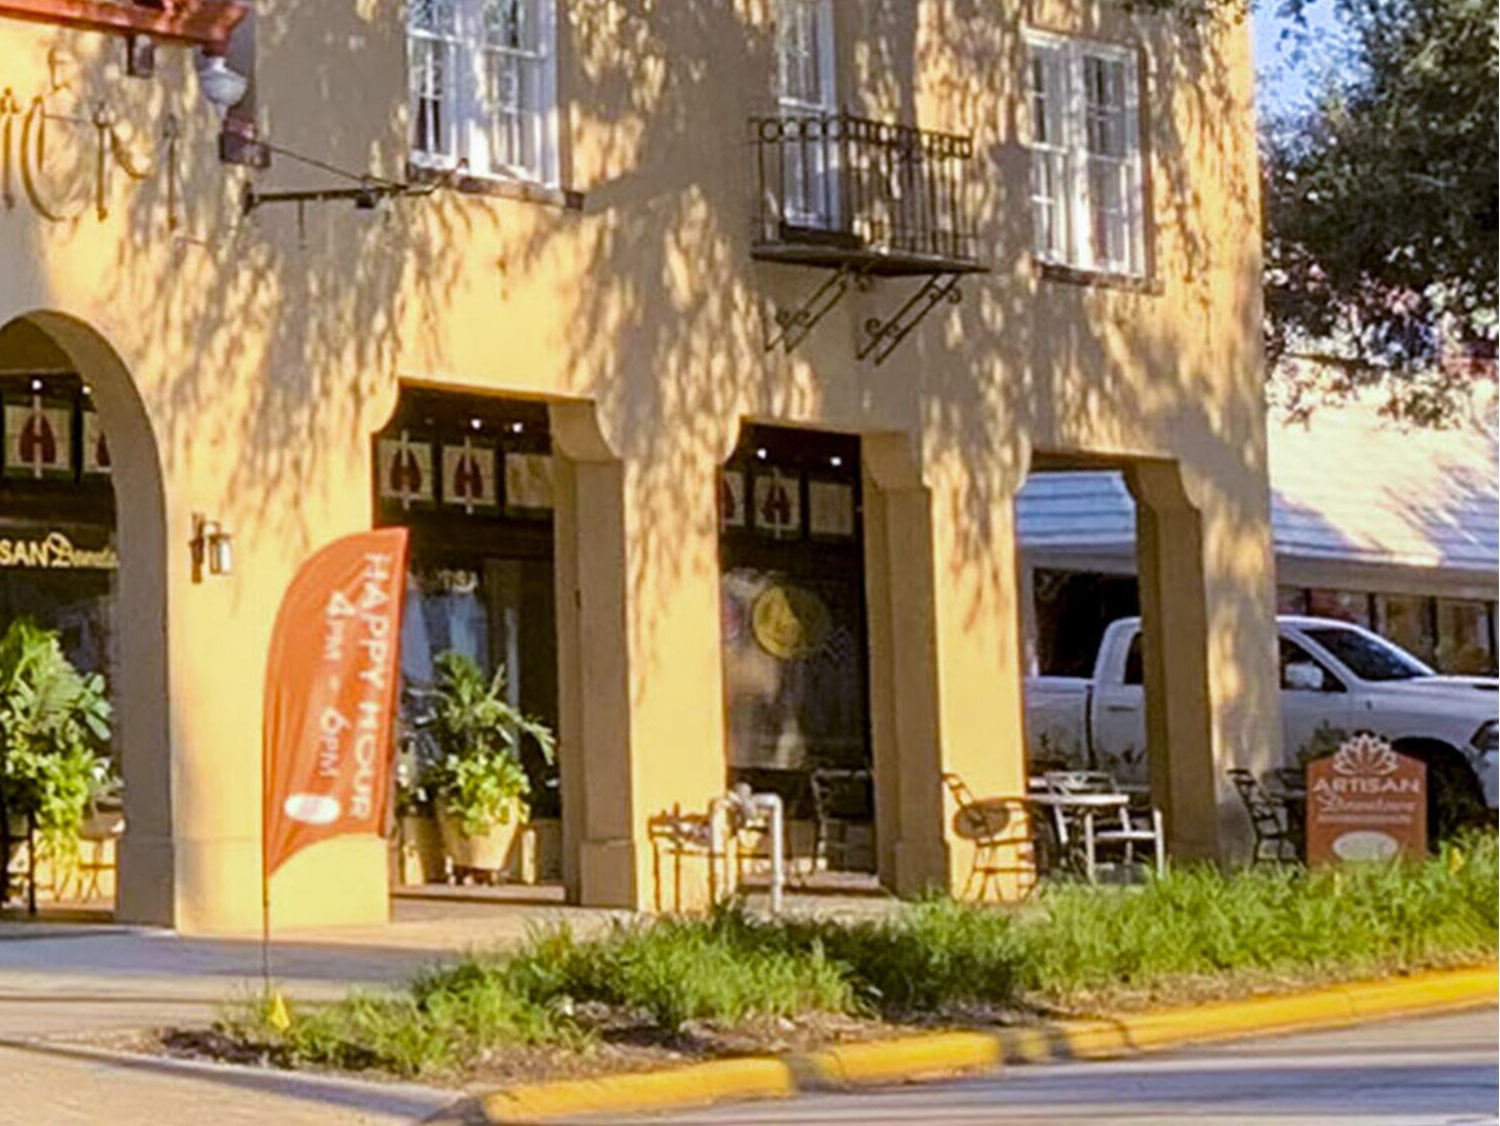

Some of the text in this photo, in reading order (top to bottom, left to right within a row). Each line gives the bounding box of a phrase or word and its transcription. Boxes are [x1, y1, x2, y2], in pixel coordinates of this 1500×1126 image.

[350, 552, 392, 819] HAPPY HOUR
[1312, 777, 1421, 794] ARTISAN
